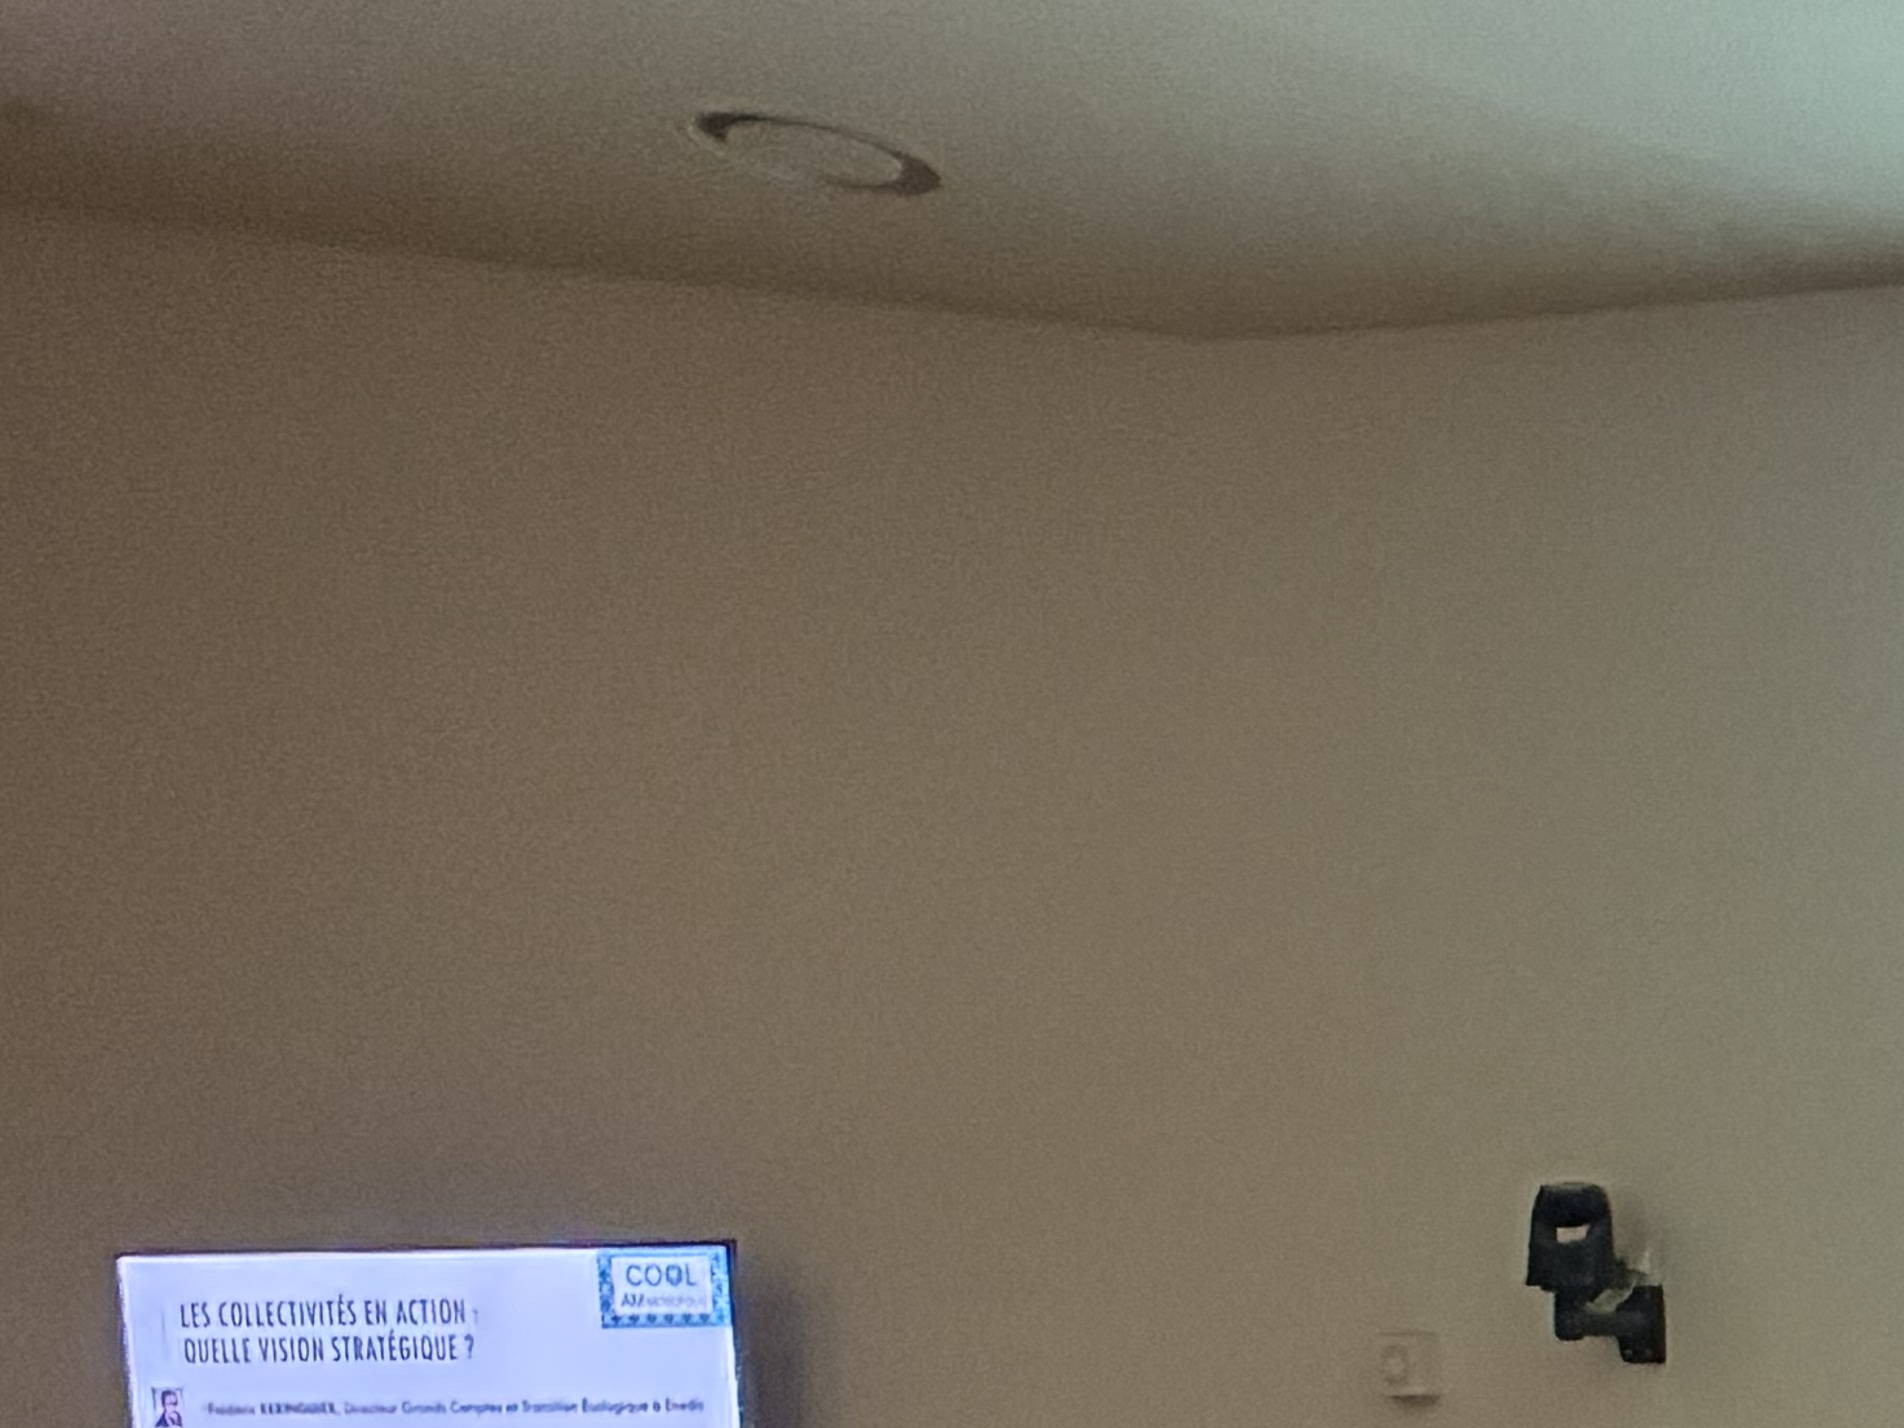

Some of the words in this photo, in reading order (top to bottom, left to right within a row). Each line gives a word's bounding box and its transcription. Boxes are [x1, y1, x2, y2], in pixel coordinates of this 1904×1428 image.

[626, 1263, 698, 1286] COOL
[179, 1301, 211, 1329] LES
[218, 1294, 357, 1328] COLLECTIVITÉS
[363, 1299, 388, 1326] EN
[396, 1298, 466, 1326] ACTION
[184, 1337, 251, 1364] QUELLE
[258, 1336, 324, 1363] VISION
[330, 1328, 458, 1363] STRATÉGIQUE
[463, 1333, 475, 1359] ?
